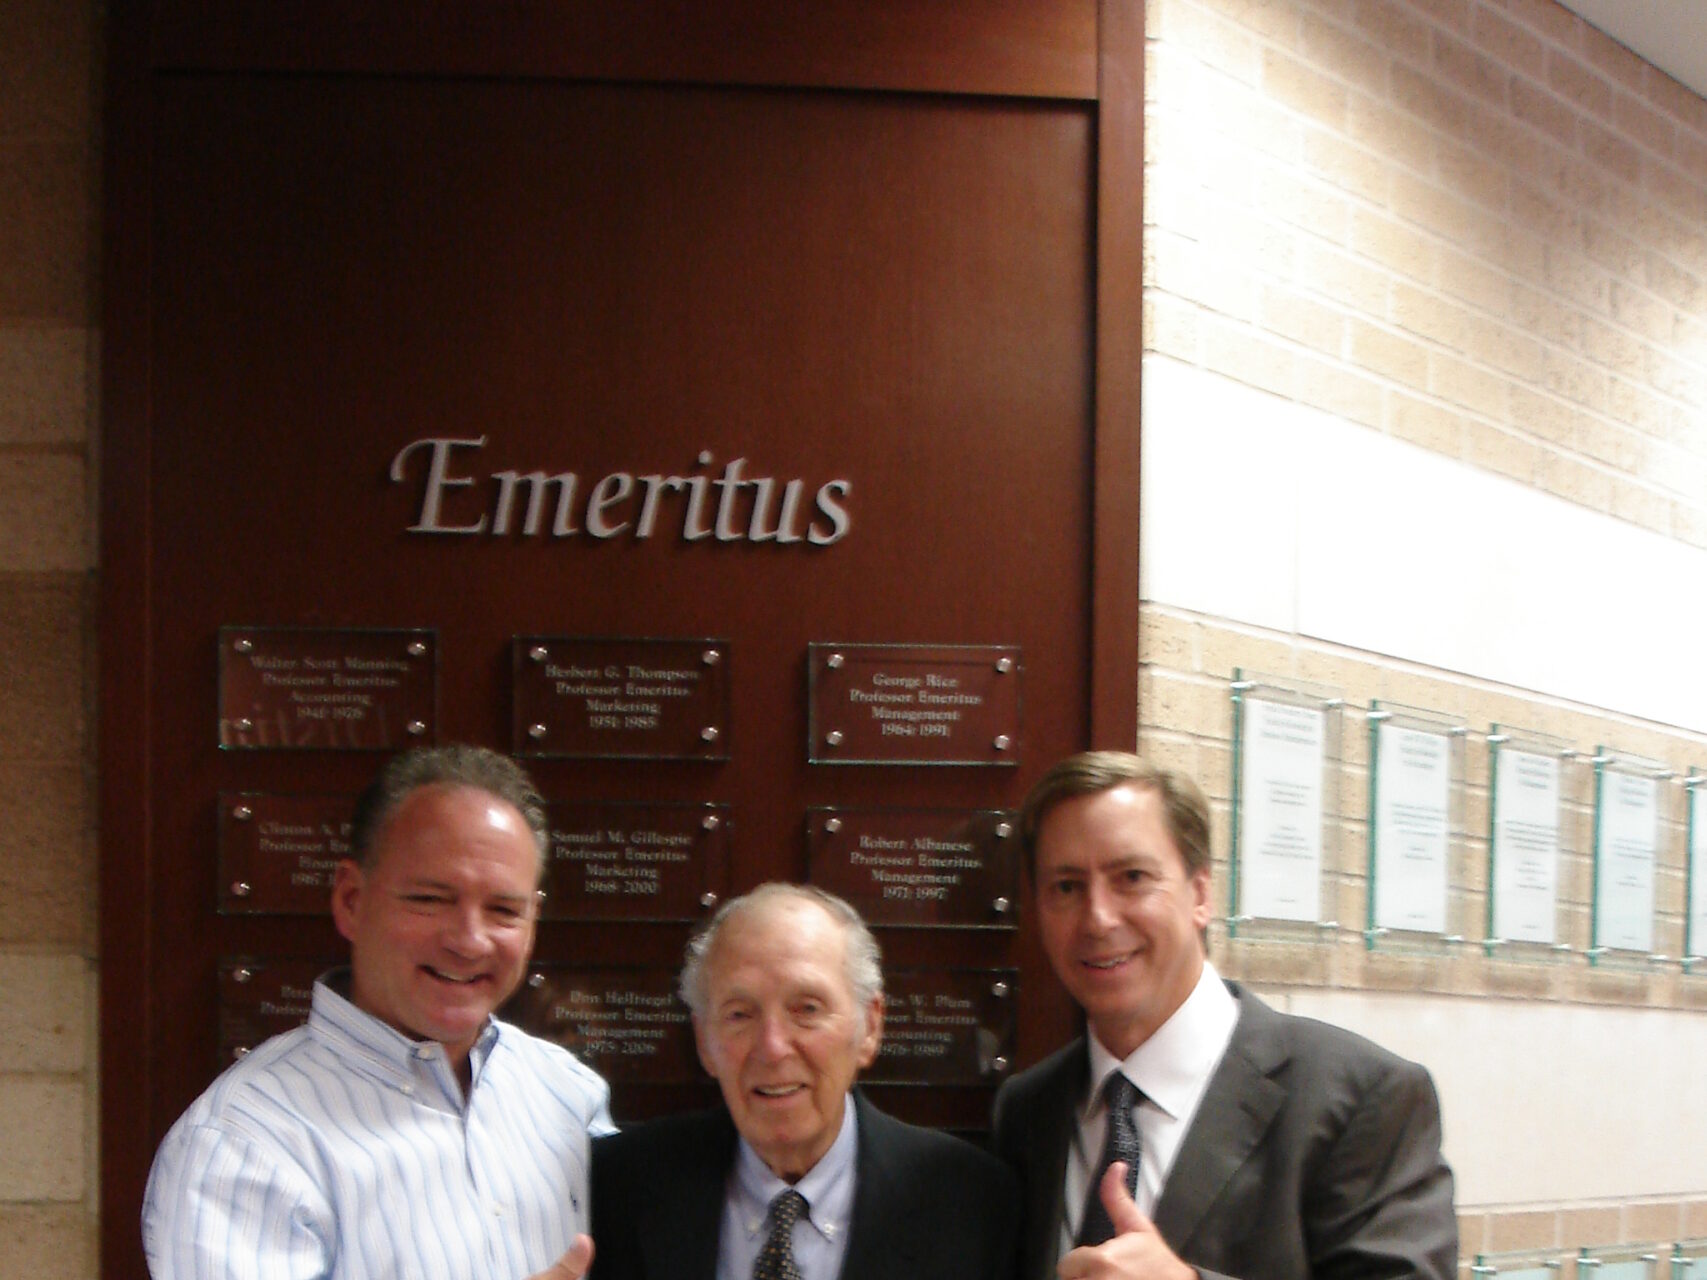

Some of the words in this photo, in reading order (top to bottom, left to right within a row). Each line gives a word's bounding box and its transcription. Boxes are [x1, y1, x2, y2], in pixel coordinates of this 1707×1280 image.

[390, 434, 852, 546] Emeritus
[302, 656, 337, 669] Scott
[262, 672, 326, 685] Professor
[332, 673, 398, 686] Emeritus
[545, 665, 599, 678] Herbert
[627, 666, 699, 681] Thompson
[872, 673, 919, 689] George
[926, 674, 958, 687] Rice
[556, 682, 620, 695] Professor
[626, 683, 689, 696] Emeritus
[849, 689, 912, 703] Professor
[918, 691, 982, 704] Emeritus
[291, 691, 372, 705] Accounting
[586, 699, 659, 714] Marketing
[871, 706, 960, 721] Management
[259, 838, 322, 851] Professor
[552, 831, 600, 844] Samuel
[631, 832, 691, 846] Gillespie
[859, 836, 905, 849] Robert
[911, 837, 971, 851] Albanese
[555, 847, 618, 860] Professor
[625, 848, 688, 861] Emeritus
[850, 852, 912, 866] Professor
[918, 853, 982, 867] Emeritus
[586, 864, 659, 879] Marketing
[871, 869, 959, 884] Management
[570, 990, 599, 1003] Don
[935, 994, 971, 1008] Plum
[555, 1007, 618, 1020] Professor
[624, 1008, 687, 1021] Emeritus
[915, 1011, 978, 1024] Emeritus
[577, 1024, 664, 1039] Management
